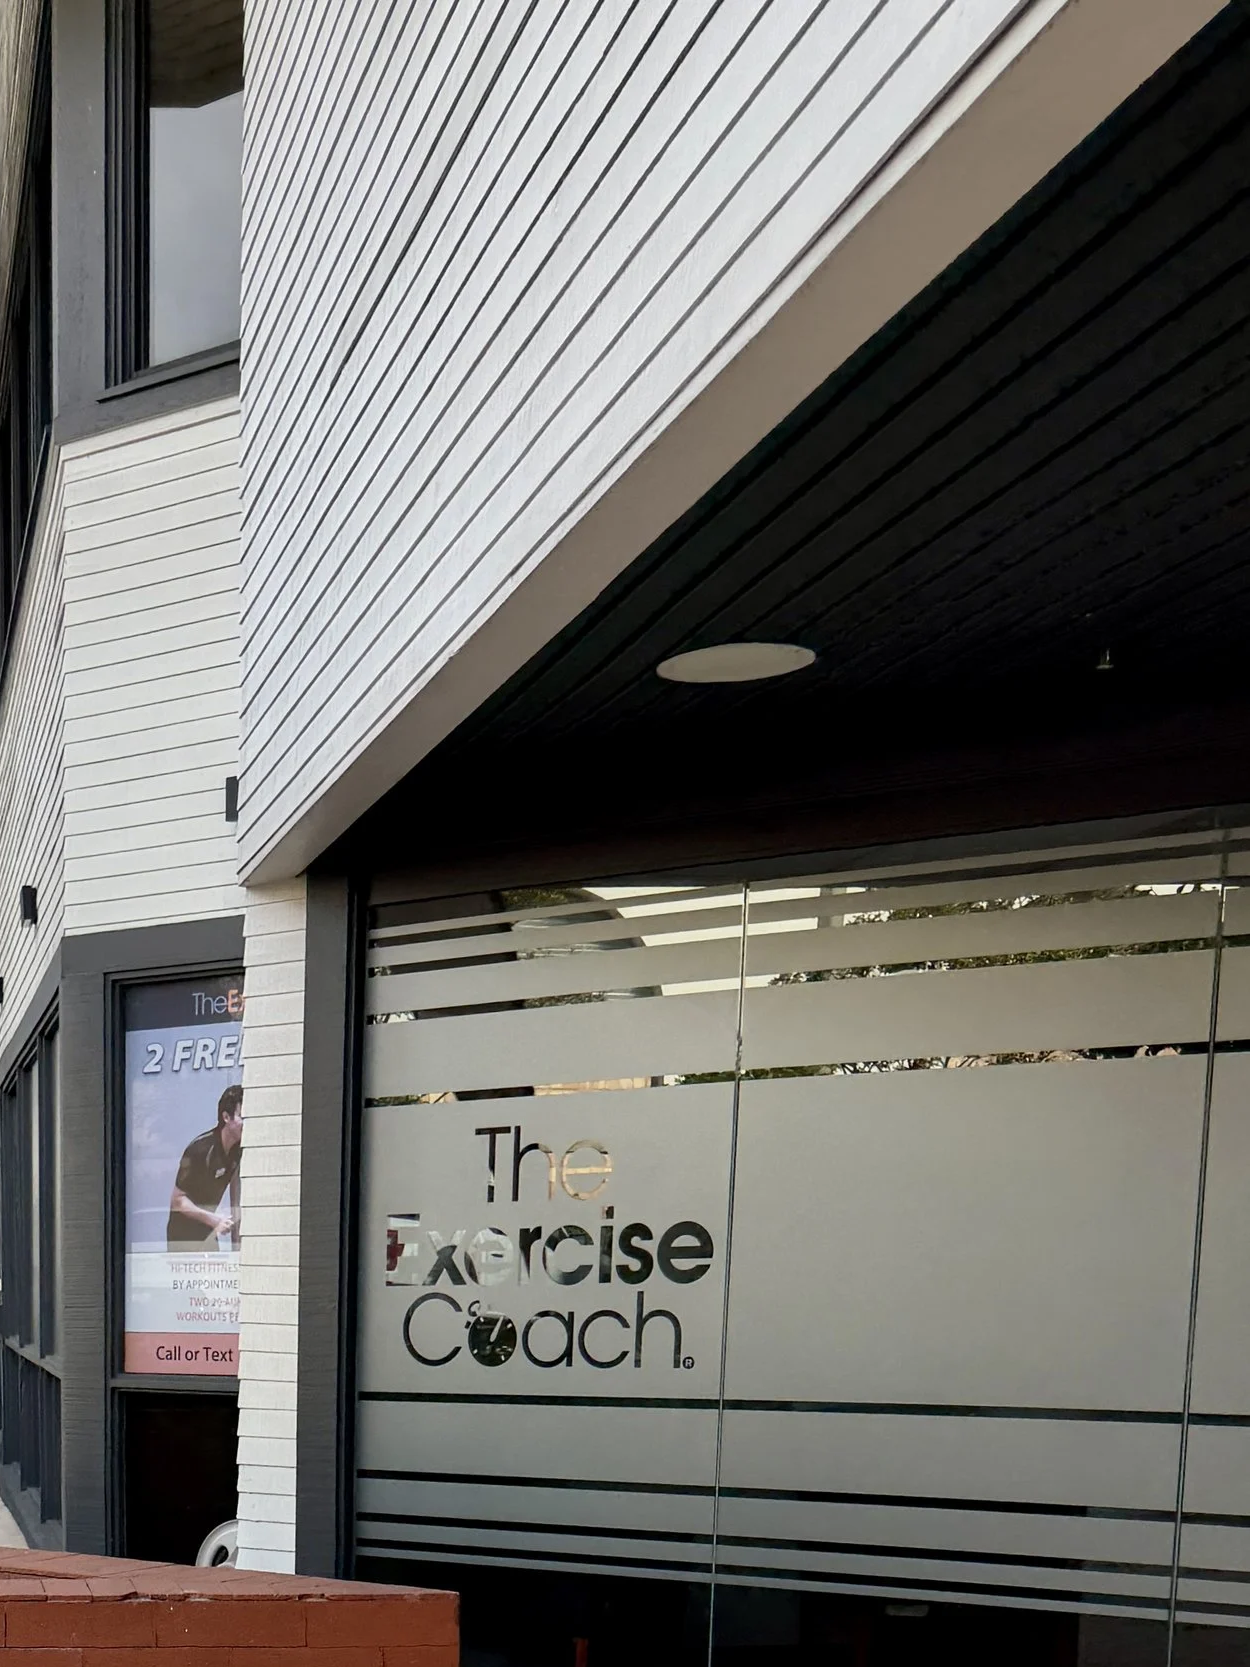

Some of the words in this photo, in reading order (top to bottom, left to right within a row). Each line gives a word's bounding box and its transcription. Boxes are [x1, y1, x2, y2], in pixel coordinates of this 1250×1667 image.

[142, 1042, 165, 1074] 2
[172, 1035, 245, 1073] FRE
[475, 1125, 613, 1203] The
[385, 1205, 714, 1287] Exercise
[208, 1262, 240, 1273] FITNES
[173, 1280, 184, 1290] BY
[186, 1279, 240, 1290] APPOINTME
[189, 1297, 210, 1307] TWO
[176, 1311, 227, 1321] WORKOUTS
[155, 1345, 181, 1361] Call
[185, 1350, 200, 1361] or
[203, 1346, 234, 1362] Text
